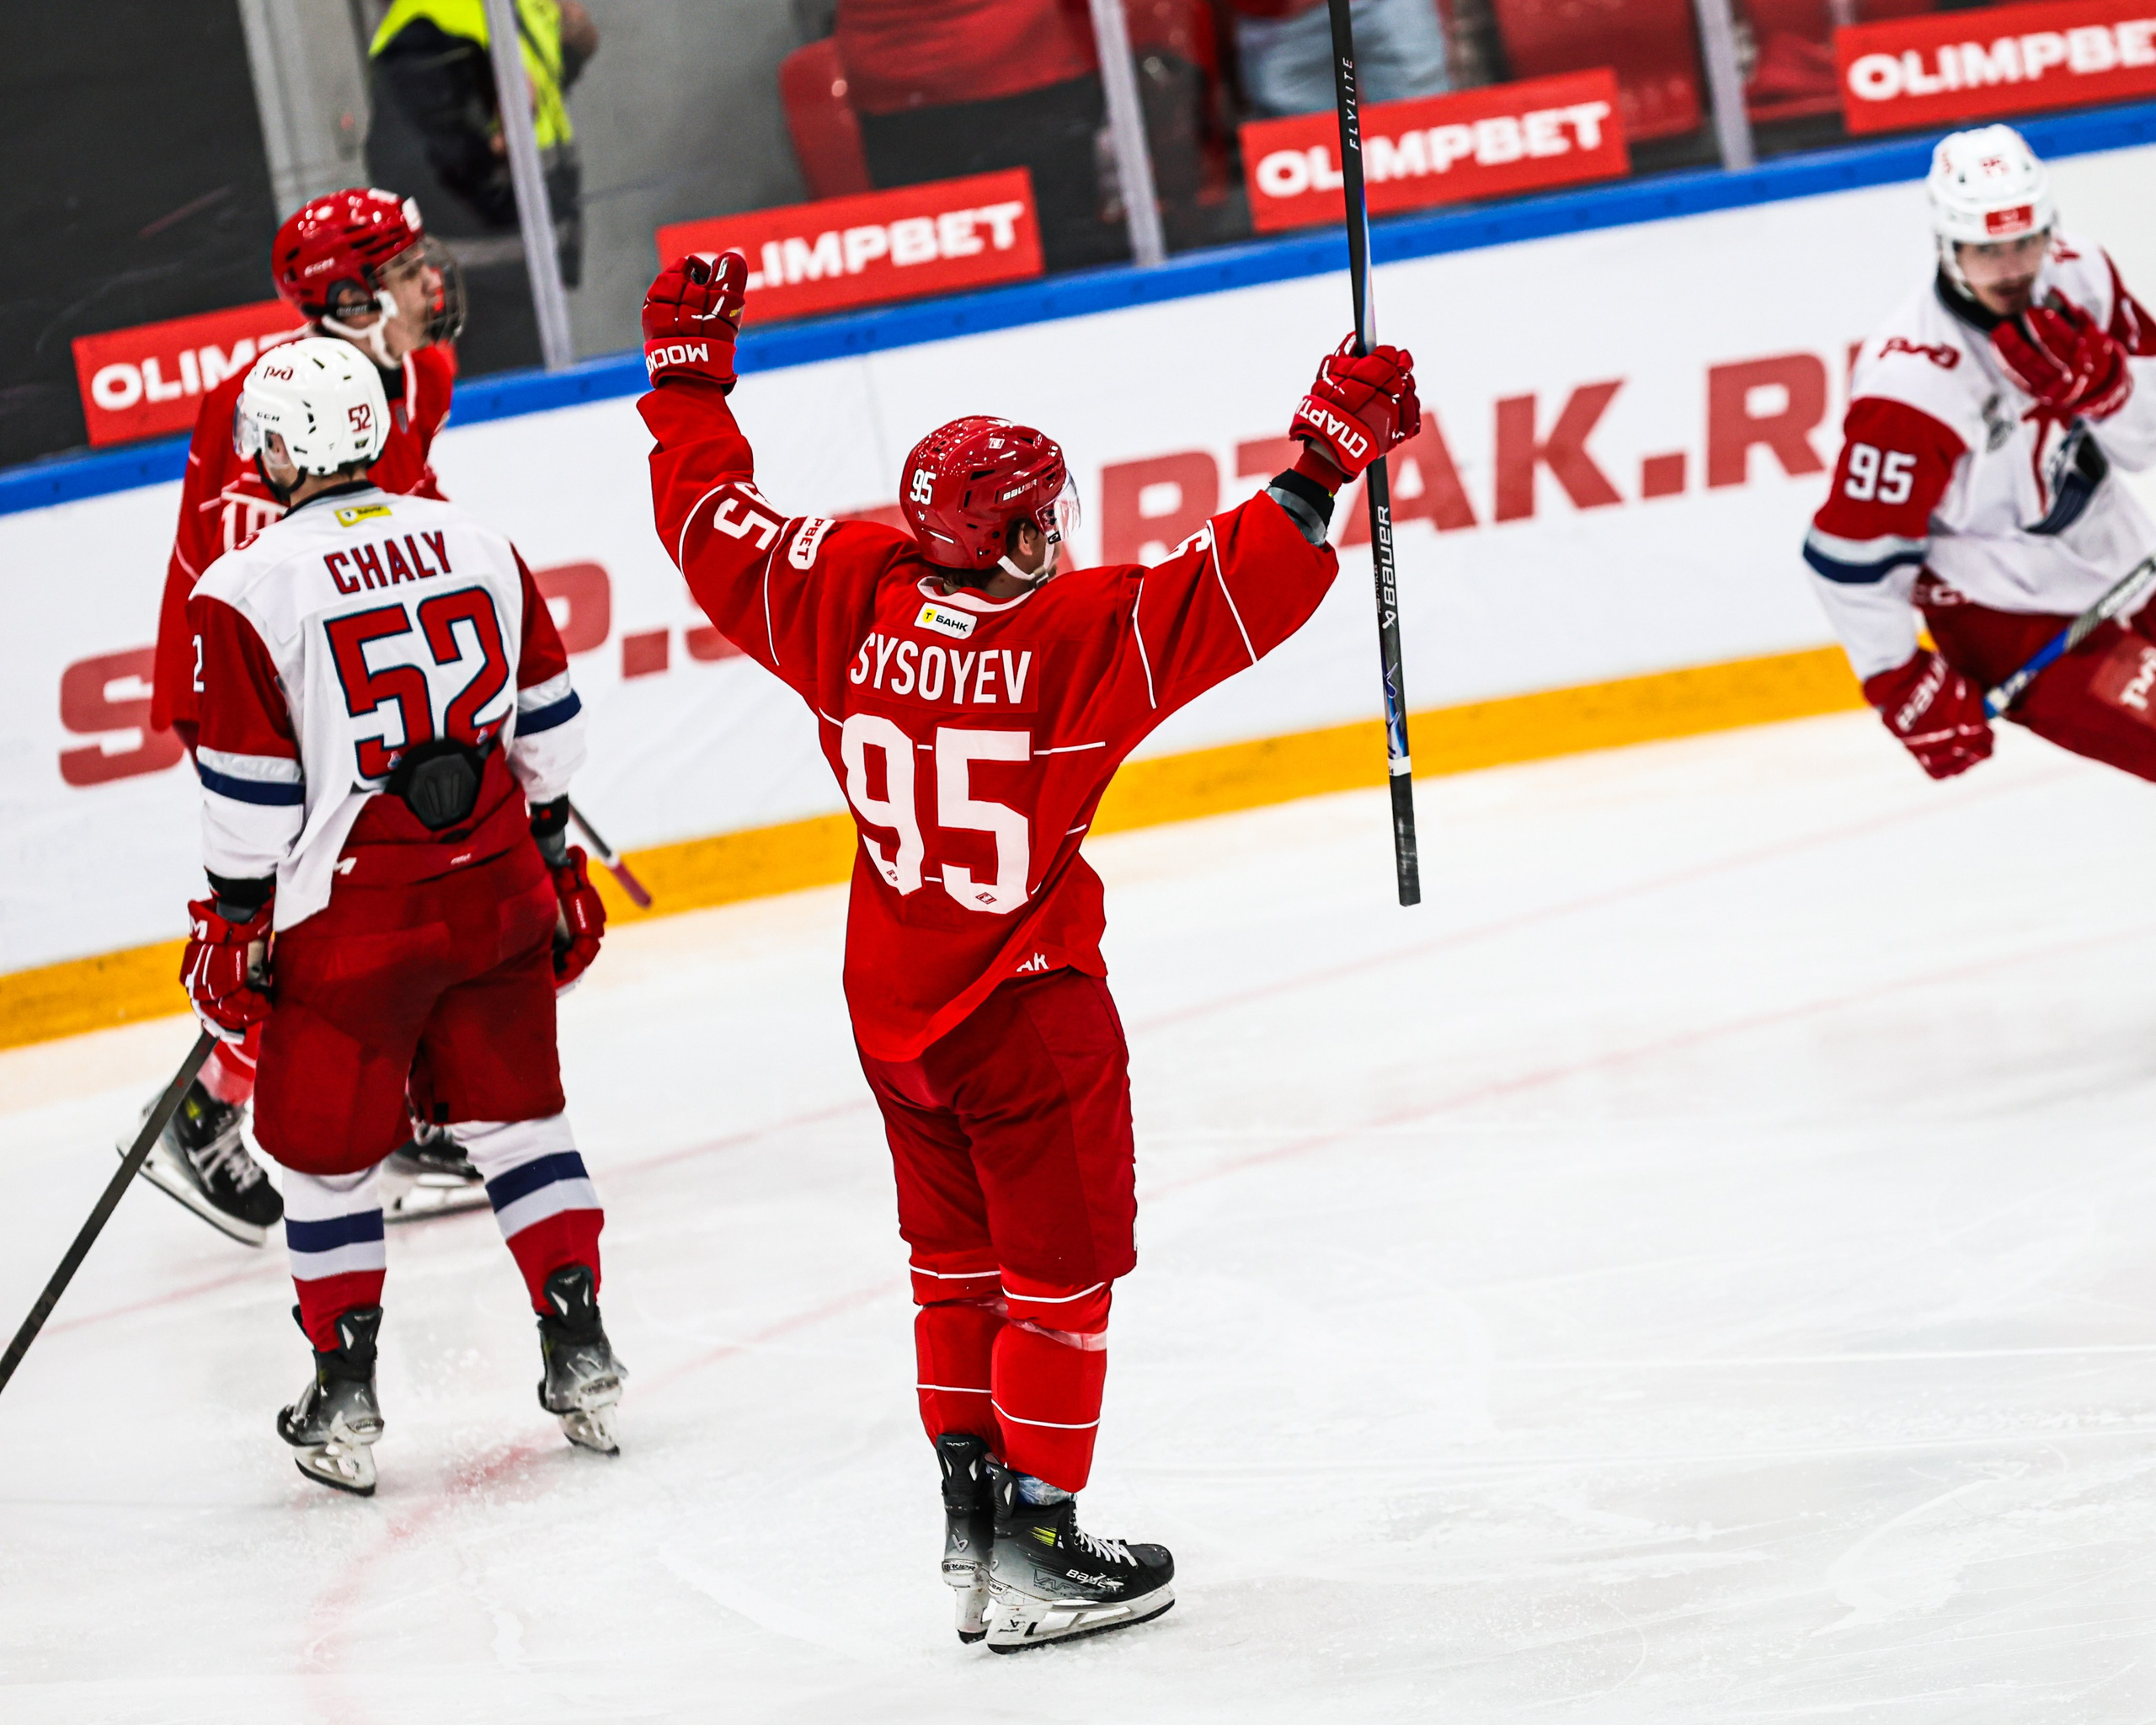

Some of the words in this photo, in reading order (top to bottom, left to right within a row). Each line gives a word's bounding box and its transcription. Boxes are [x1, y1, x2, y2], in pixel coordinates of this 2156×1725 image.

[1848, 18, 2156, 102] OLIMPBE
[1342, 56, 1359, 151] FLYLITE
[1257, 100, 1610, 198] OLMPBET
[348, 403, 372, 434] 52
[909, 467, 937, 505] 95
[1844, 441, 1917, 505] 95
[323, 530, 451, 595] CHALY
[935, 614, 969, 633] БАНК
[323, 584, 510, 780] 52
[850, 632, 1032, 705] SYSOYEV
[842, 713, 1031, 915] 95
